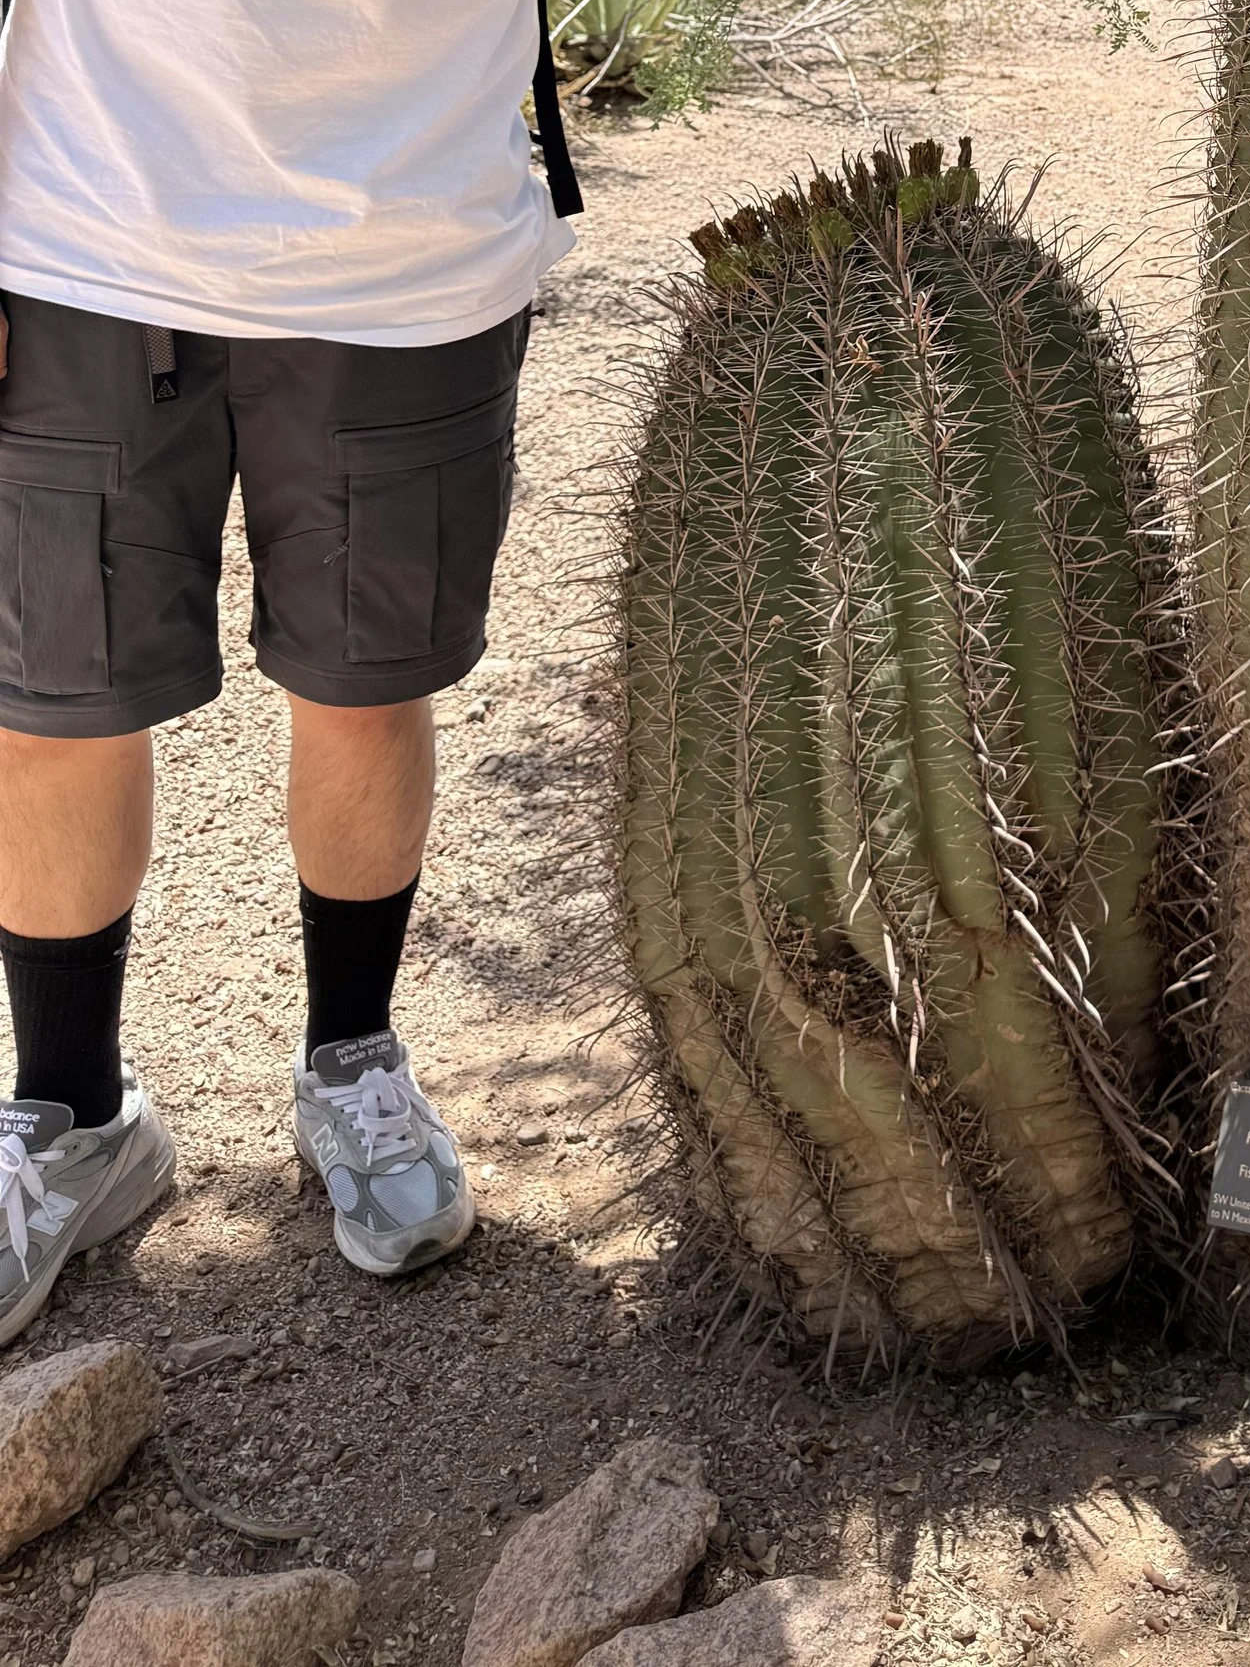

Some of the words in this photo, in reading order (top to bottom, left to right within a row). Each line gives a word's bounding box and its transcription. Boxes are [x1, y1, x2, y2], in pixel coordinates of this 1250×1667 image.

[13, 1122, 35, 1134] USA
[1213, 1192, 1229, 1204] SW
[1211, 1209, 1220, 1218] to
[1221, 1210, 1230, 1220] N
